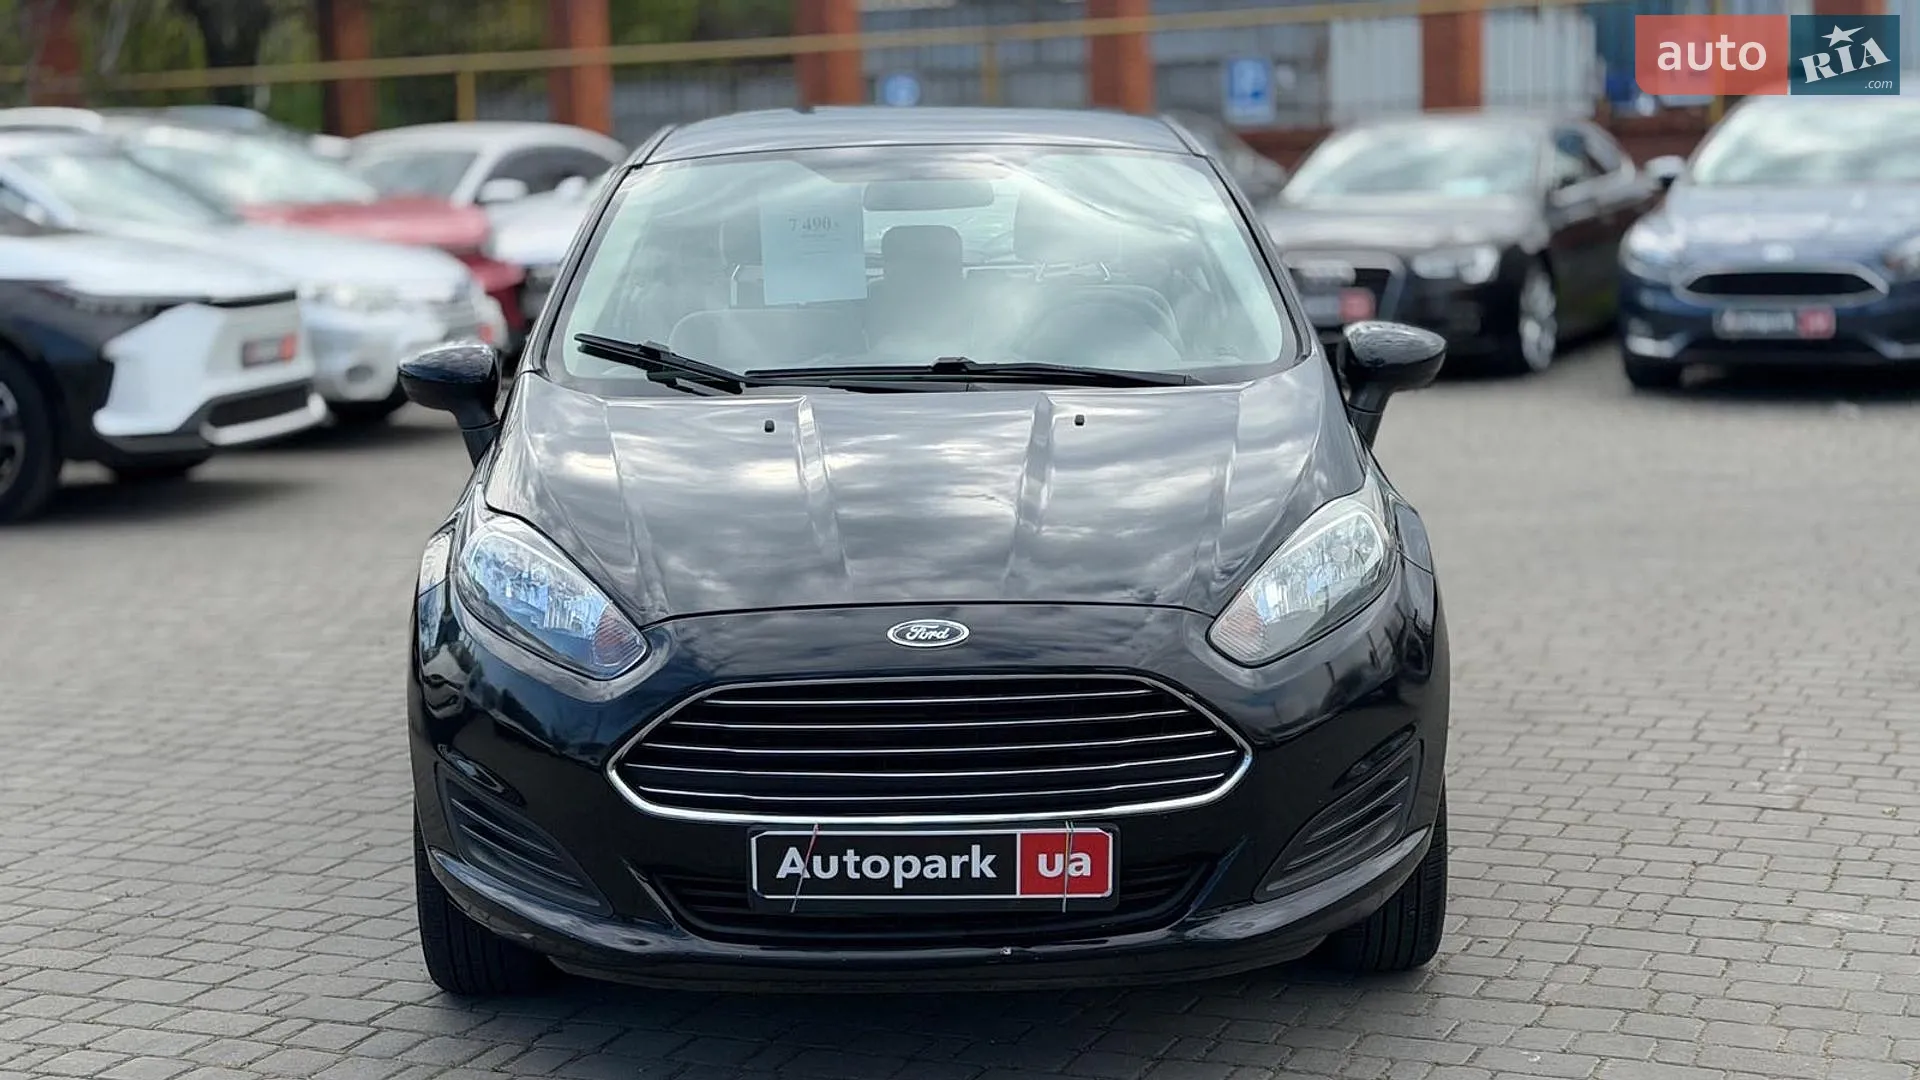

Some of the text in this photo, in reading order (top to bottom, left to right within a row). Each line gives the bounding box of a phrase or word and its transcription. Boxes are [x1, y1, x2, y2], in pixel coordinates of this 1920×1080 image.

[906, 624, 951, 640] Ford
[775, 843, 1092, 889] Autopark ua
